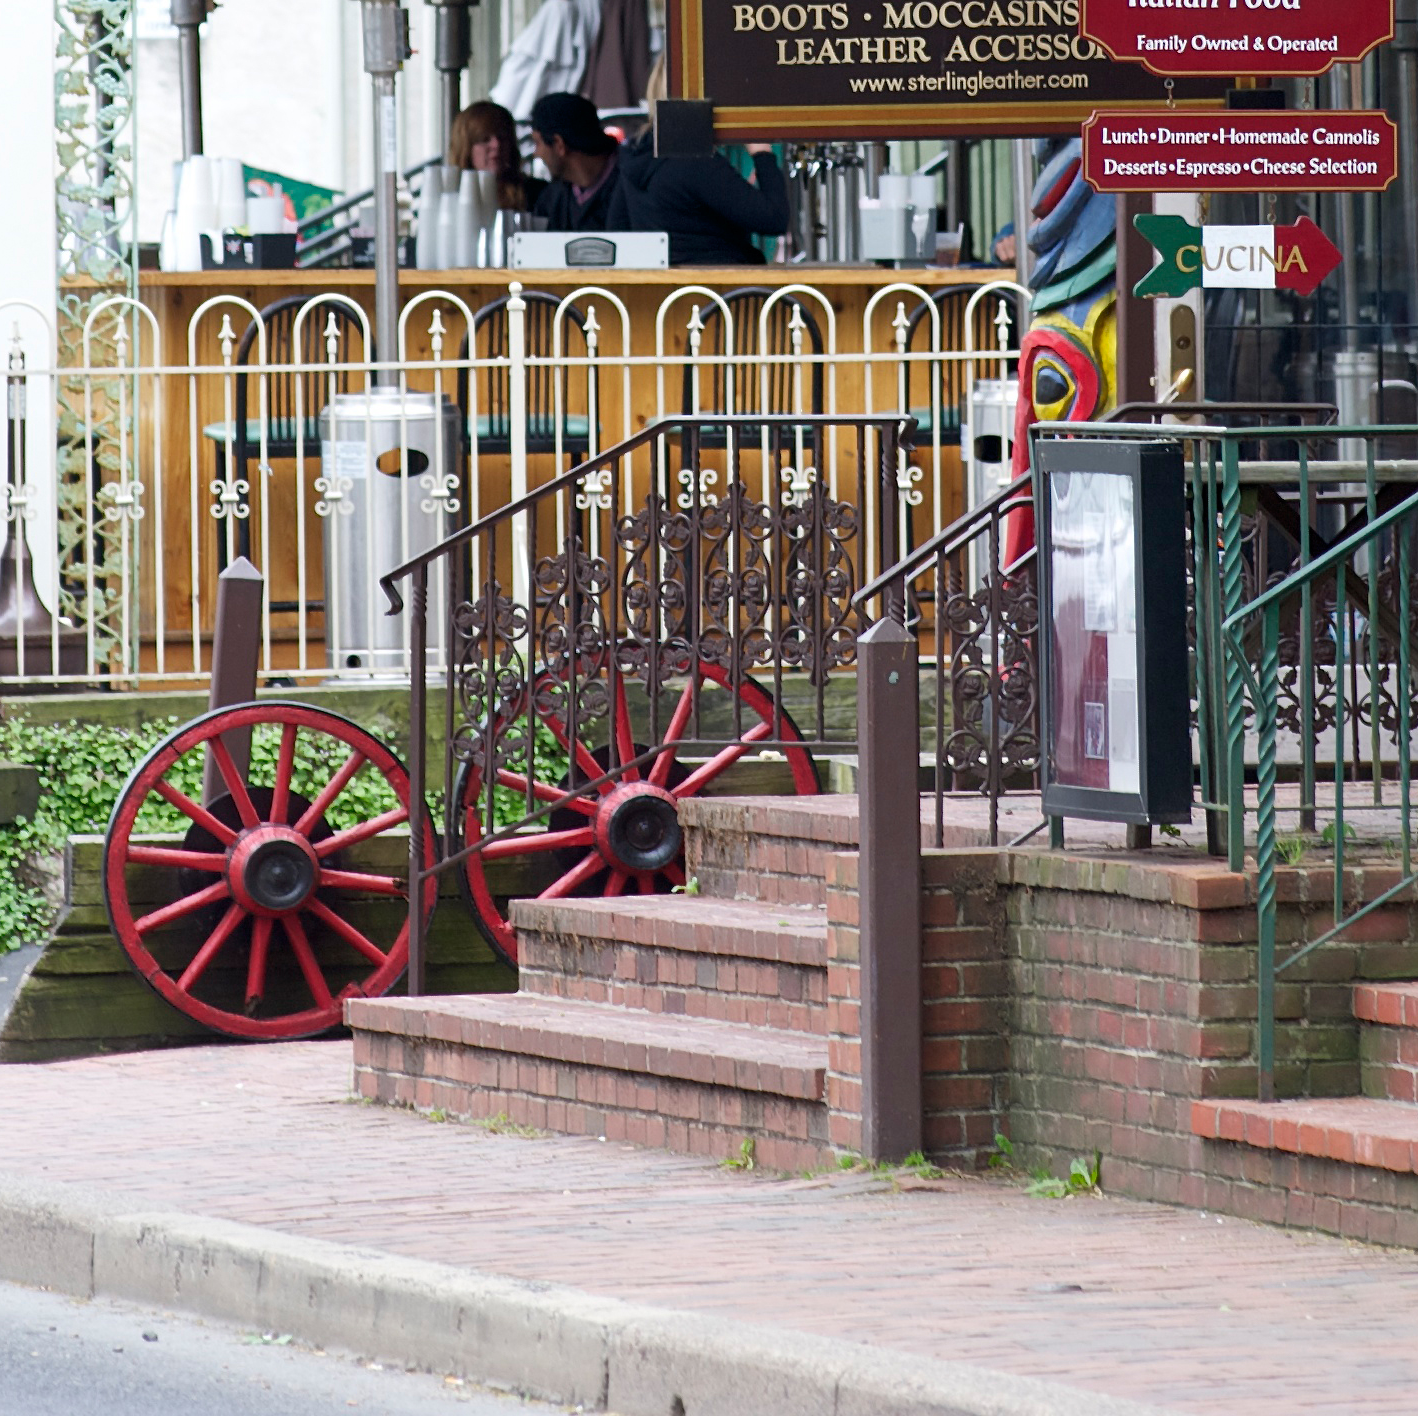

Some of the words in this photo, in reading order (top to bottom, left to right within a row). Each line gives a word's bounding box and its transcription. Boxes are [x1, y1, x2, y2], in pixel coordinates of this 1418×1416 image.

[732, 2, 849, 32] BOOTS
[882, 0, 1080, 29] MOCCASINS
[776, 36, 931, 65] LEATHER
[1137, 34, 1188, 54] Family
[1191, 34, 1249, 52] Owned
[1253, 36, 1265, 51] &
[1267, 35, 1339, 54] Operated
[849, 70, 1089, 97] www.sterlingleather.com
[1102, 127, 1149, 145] Lunch
[1219, 127, 1309, 145] Homemade
[1312, 127, 1380, 146] Cannolis
[1103, 158, 1167, 176] Desserts
[1176, 158, 1241, 178] Espresso
[1250, 157, 1306, 175] Cheese
[1309, 157, 1378, 175] Selection
[1175, 244, 1309, 273] CUCINA
